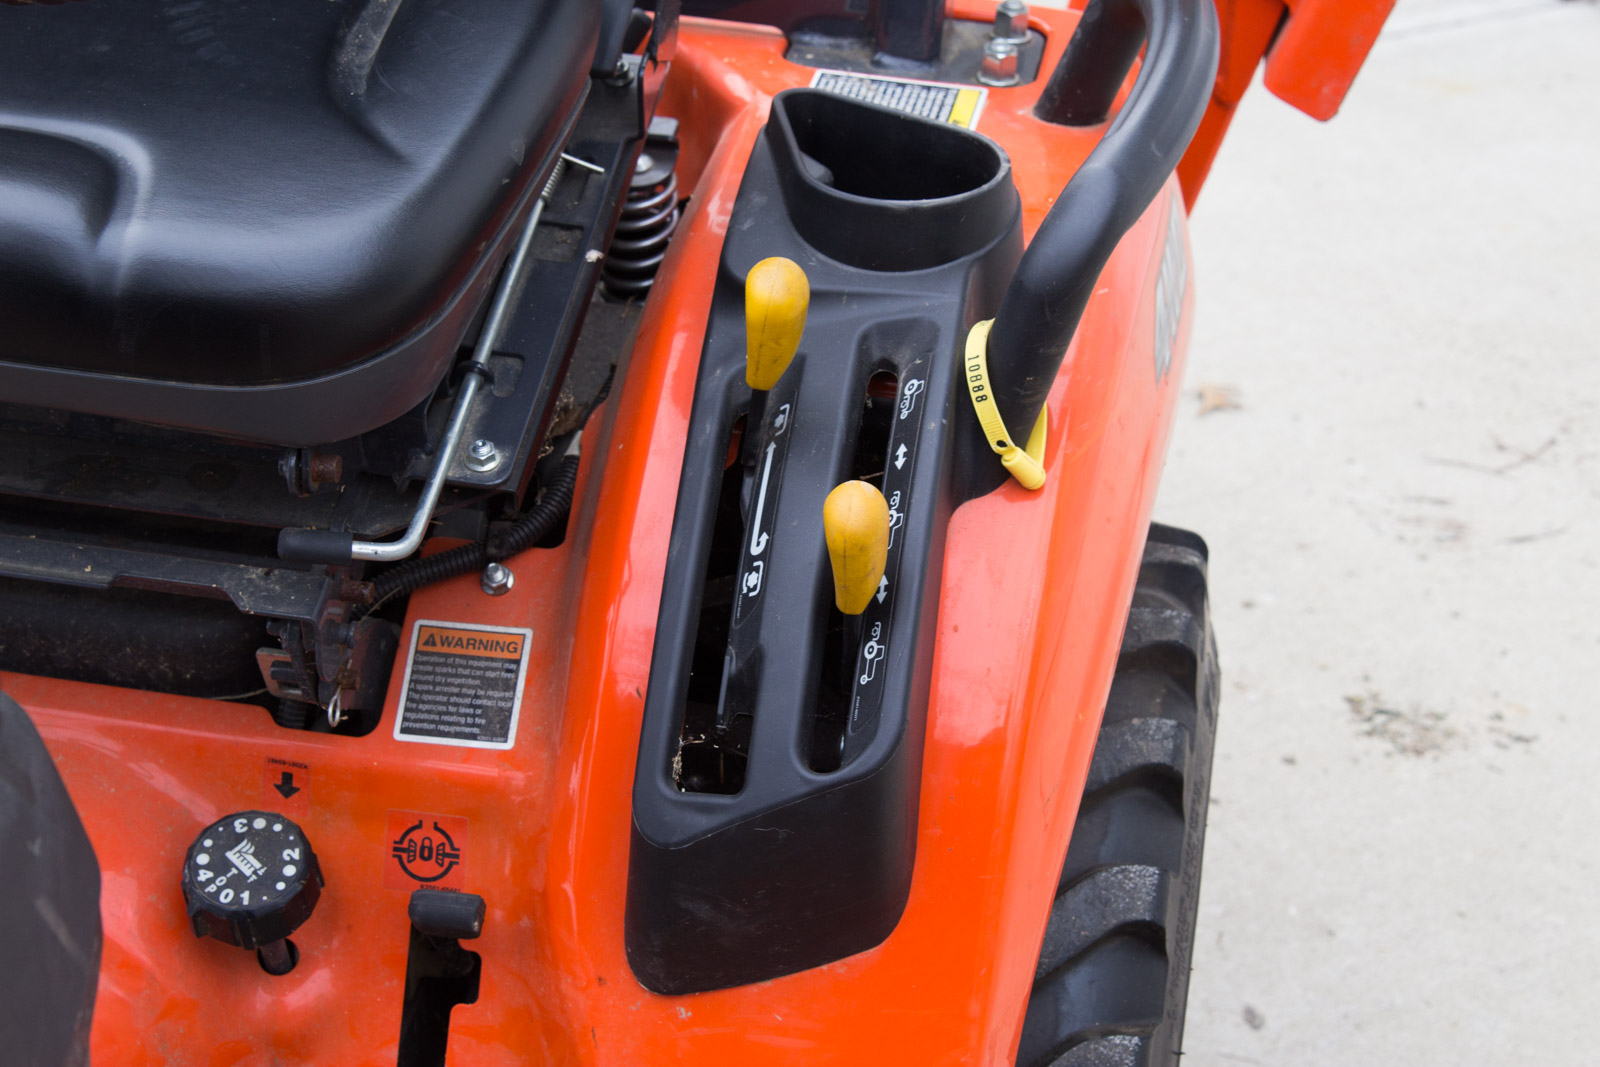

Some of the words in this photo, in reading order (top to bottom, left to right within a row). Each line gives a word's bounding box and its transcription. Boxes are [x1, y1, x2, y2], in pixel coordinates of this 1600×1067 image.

[967, 354, 988, 404] 10888
[440, 634, 518, 654] WARNING
[415, 654, 445, 663] Operation
[468, 660, 502, 668] equipment
[412, 674, 433, 682] around
[435, 676, 445, 684] dry
[461, 688, 476, 696] may
[450, 696, 471, 704] should
[472, 698, 496, 706] contact
[417, 704, 447, 712] agencies
[404, 712, 440, 721] regulations
[441, 715, 465, 724] relating
[402, 722, 436, 730] prevention
